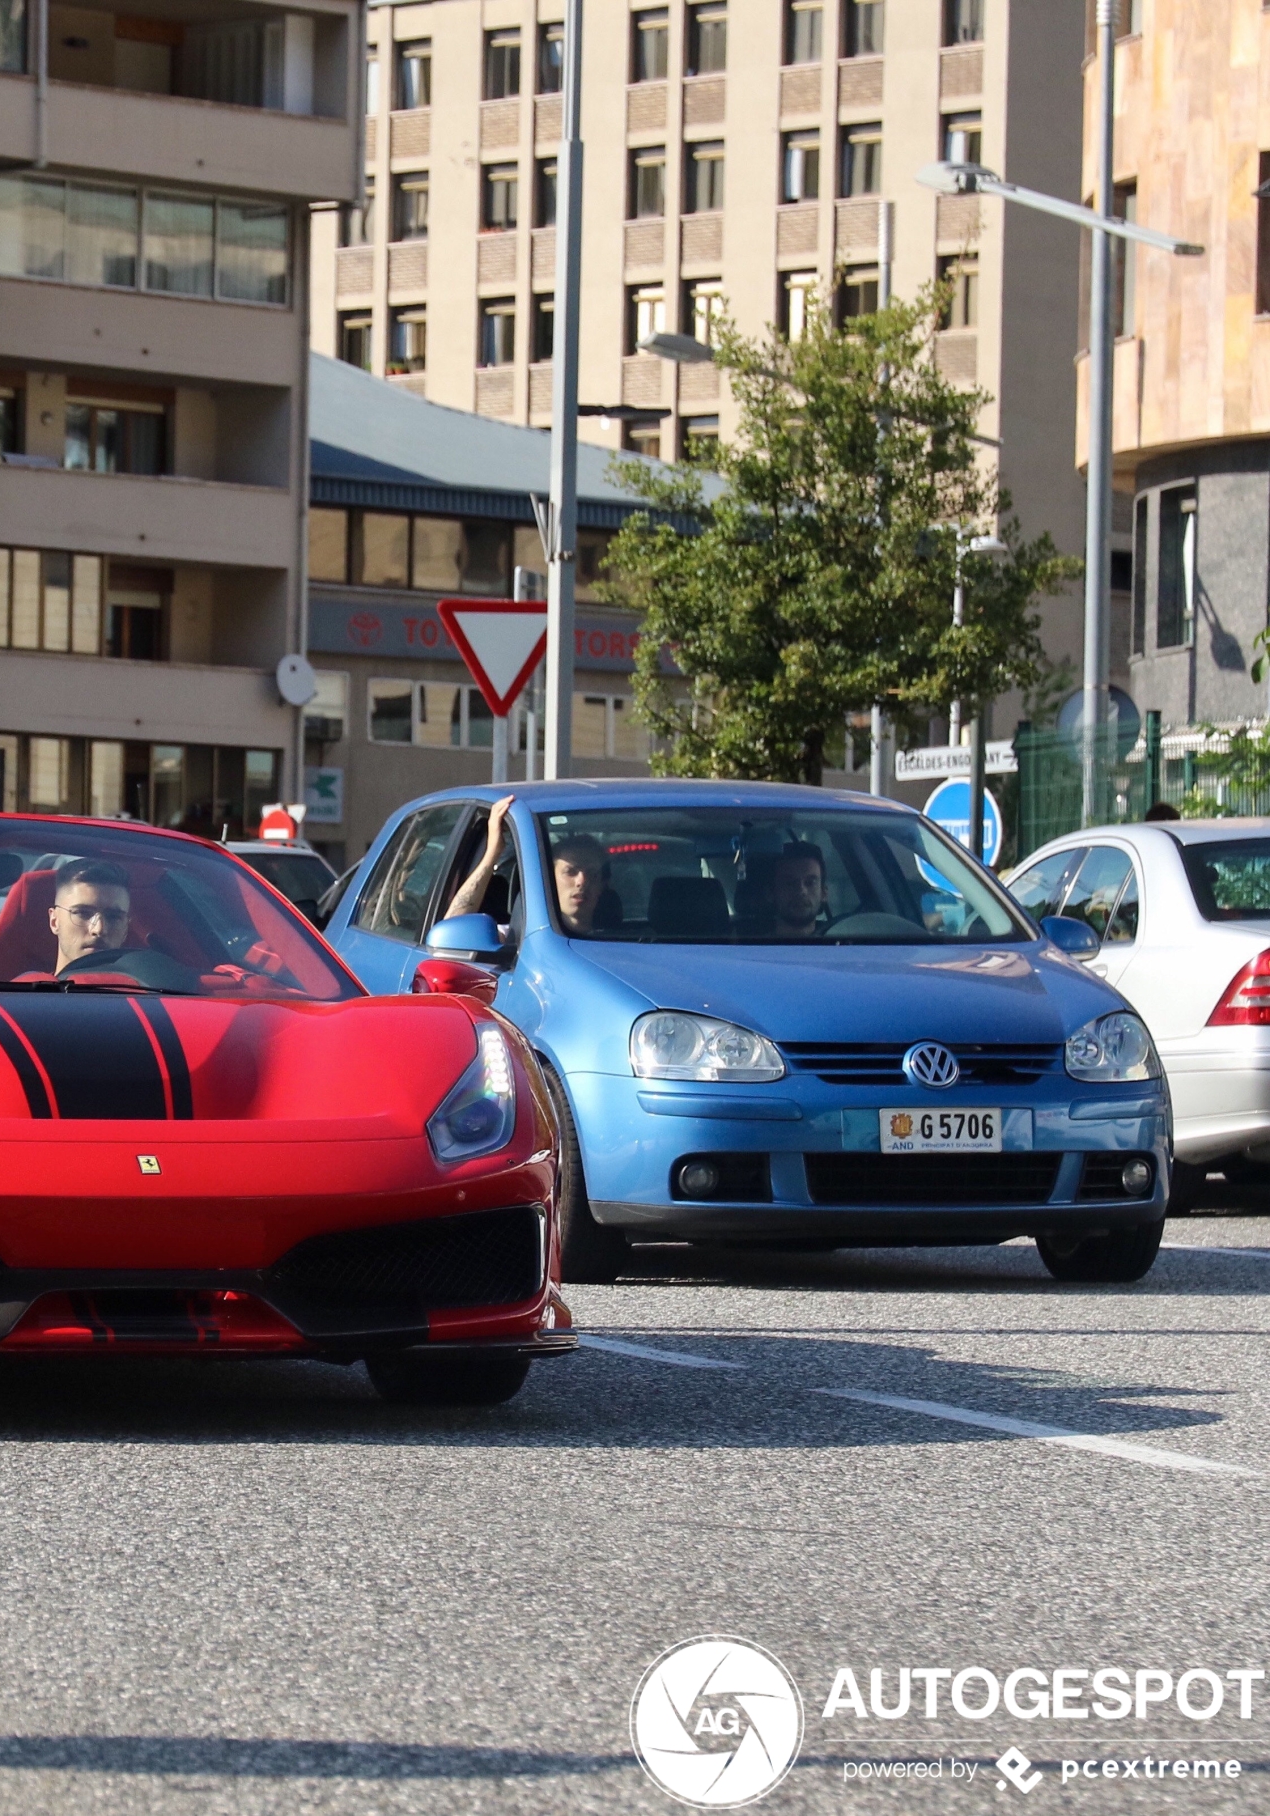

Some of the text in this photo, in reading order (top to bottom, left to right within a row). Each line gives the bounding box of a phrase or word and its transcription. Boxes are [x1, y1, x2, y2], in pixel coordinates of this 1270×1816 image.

[897, 751, 1001, 773] ESCALDES-ENGONY
[920, 1113, 994, 1139] G 5706
[891, 1141, 914, 1151] AND
